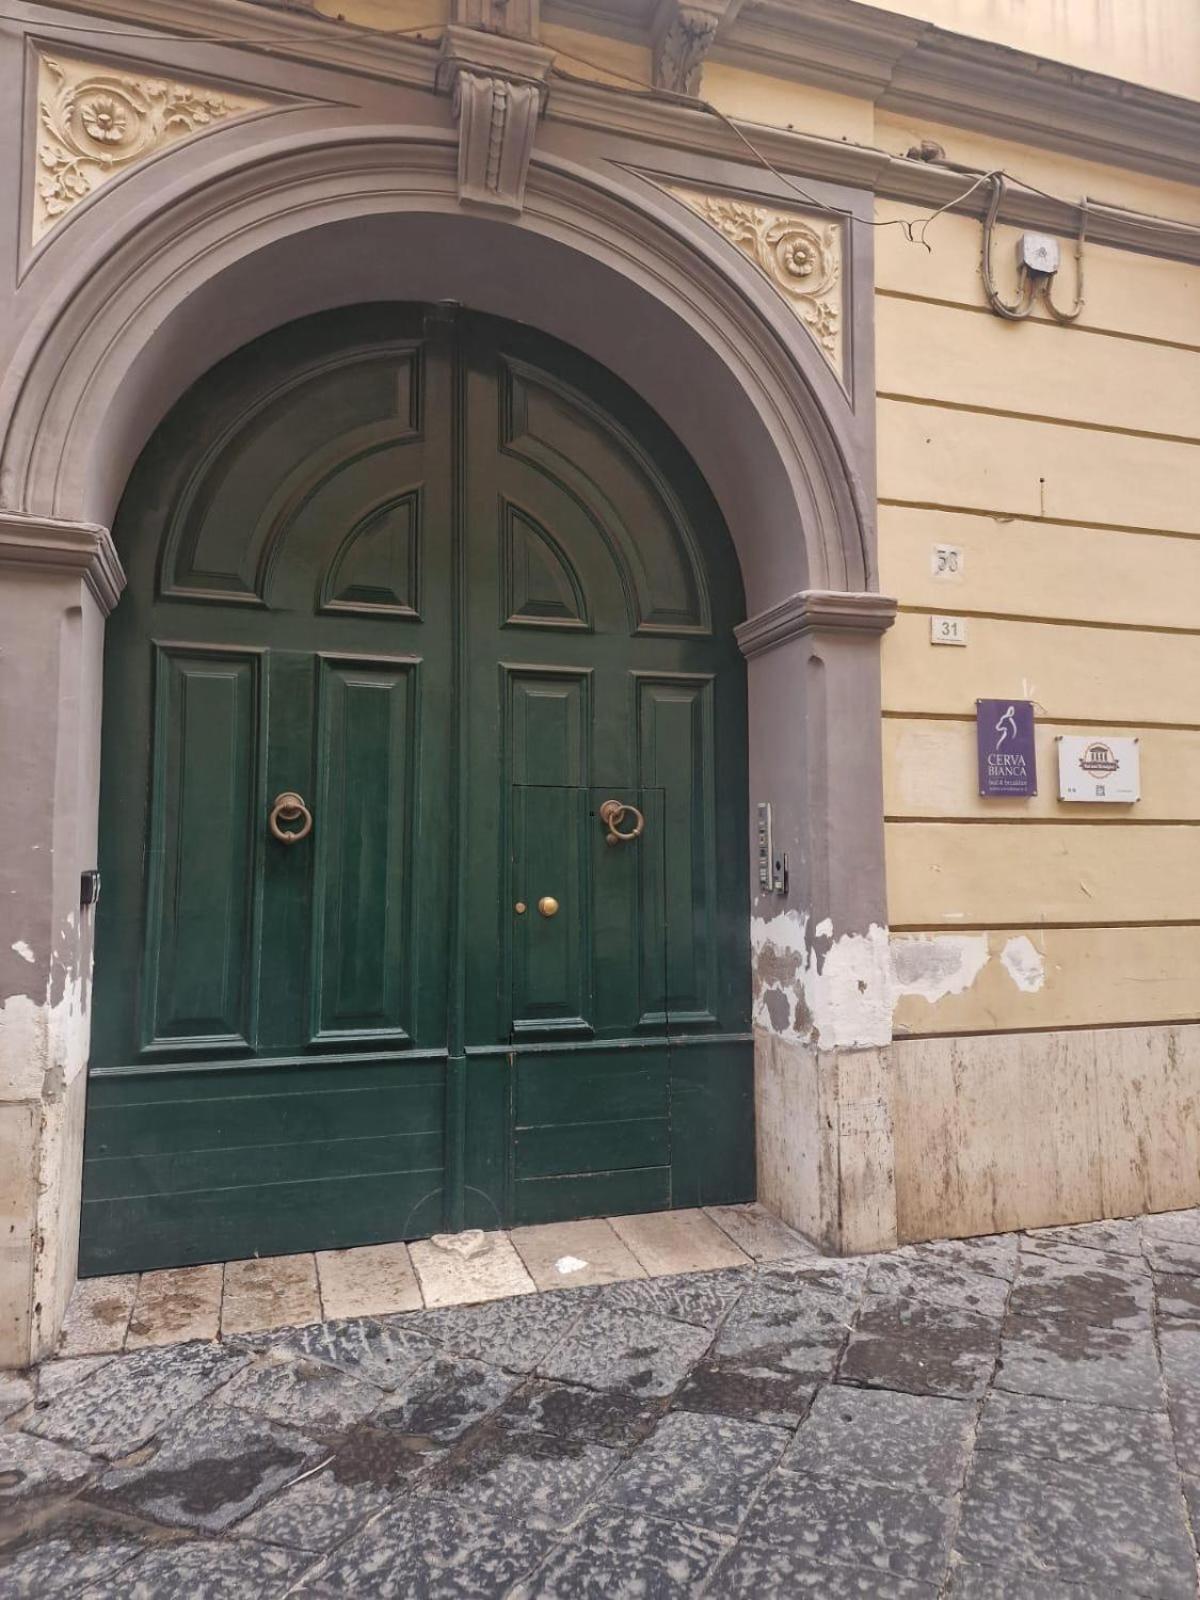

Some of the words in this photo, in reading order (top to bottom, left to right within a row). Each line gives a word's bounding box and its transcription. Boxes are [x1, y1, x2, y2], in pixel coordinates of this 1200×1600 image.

[941, 621, 958, 636] 31
[987, 753, 1026, 766] CERVA
[988, 766, 1027, 777] BIANCA
